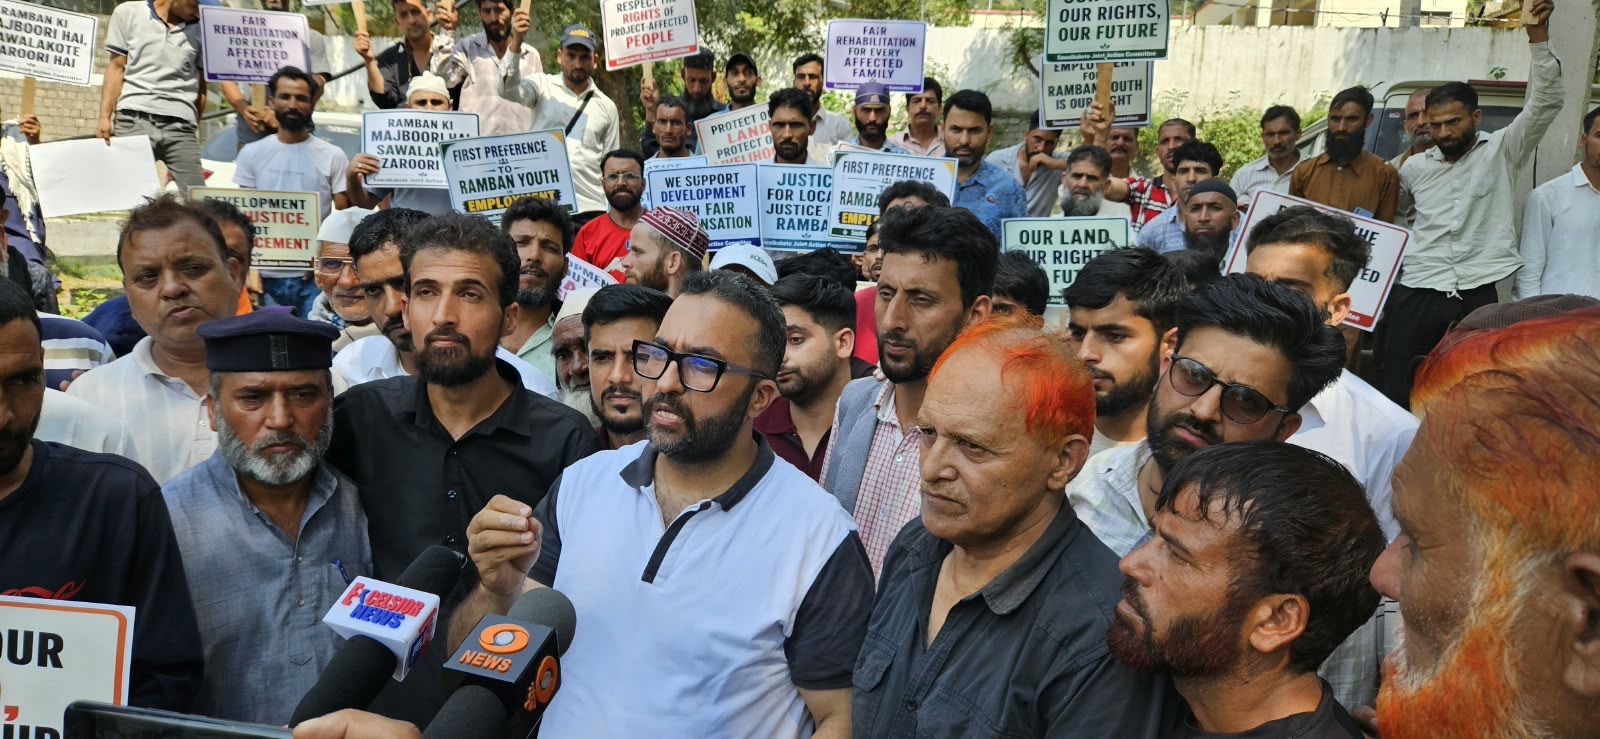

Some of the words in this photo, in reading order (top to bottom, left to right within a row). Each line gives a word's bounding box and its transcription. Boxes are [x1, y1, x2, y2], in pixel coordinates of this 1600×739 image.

[617, 0, 657, 12] RESPECT
[1059, 8, 1092, 23] OUR
[1097, 3, 1161, 21] RIGHTS,
[1, 6, 52, 25] RAMBAN
[54, 17, 68, 28] KI
[241, 16, 267, 26] FAIR
[623, 8, 661, 24] RIGHTS
[664, 6, 675, 17] OF
[213, 24, 298, 39] REHABILITATION
[610, 15, 688, 38] PROJECT-AFFECTED
[863, 26, 887, 35] FAIR
[1058, 27, 1091, 42] OUR
[1096, 22, 1158, 40] FUTURE
[62, 30, 87, 46] HAI,
[229, 38, 249, 46] FOR
[253, 39, 283, 49] EVERY
[626, 29, 675, 49] PEOPLE
[836, 36, 916, 47] REHABILITATION
[227, 48, 289, 60] AFFECTED
[848, 47, 866, 56] FOR
[870, 48, 900, 57] EVERY
[54, 55, 76, 68] HAI
[238, 60, 280, 71] FAMILY
[844, 58, 903, 68] AFFECTED
[1054, 61, 1135, 72] EMPLOENT
[853, 69, 894, 79] FAMILY
[1111, 79, 1143, 92] OUTH
[1056, 99, 1066, 110] IS
[1110, 94, 1133, 106] GHT
[388, 119, 438, 129] RAMBAN
[442, 121, 454, 129] KI
[710, 113, 756, 135] PROTECT
[371, 131, 444, 143] MAJBOORI
[453, 147, 482, 163] FIRST
[485, 140, 548, 160] PREFERENCE
[717, 137, 761, 159] PROTECT
[382, 158, 440, 170] ZAROORI
[498, 165, 512, 174] TO
[843, 160, 869, 175] FIRST
[872, 163, 936, 180] PREFERENCE
[459, 174, 516, 195] RAMBAN
[517, 169, 560, 191] YOUTH
[665, 177, 681, 188] WE
[686, 172, 740, 187] SUPPORT
[777, 172, 832, 188] JUSTIC
[468, 190, 556, 212] EMPLOYNT
[661, 185, 746, 203] DEVELOPMENT
[767, 188, 793, 201] FOR
[799, 189, 832, 203] LOCA
[840, 190, 880, 207] RAMBA
[705, 201, 735, 216] FAIR
[766, 203, 823, 217] JUSTICE
[253, 227, 269, 235] OT
[700, 215, 752, 231] NSATION
[776, 217, 828, 232] RAMBA
[253, 237, 310, 250] CEMENT
[1019, 229, 1054, 245] OUR
[1060, 228, 1110, 245] LAND
[1029, 250, 1047, 264] UR
[1053, 249, 1103, 265] RIGHT
[1361, 268, 1380, 284] ED
[350, 604, 406, 629] NEWS
[0, 629, 64, 669] UR
[459, 650, 513, 674] NEWS
